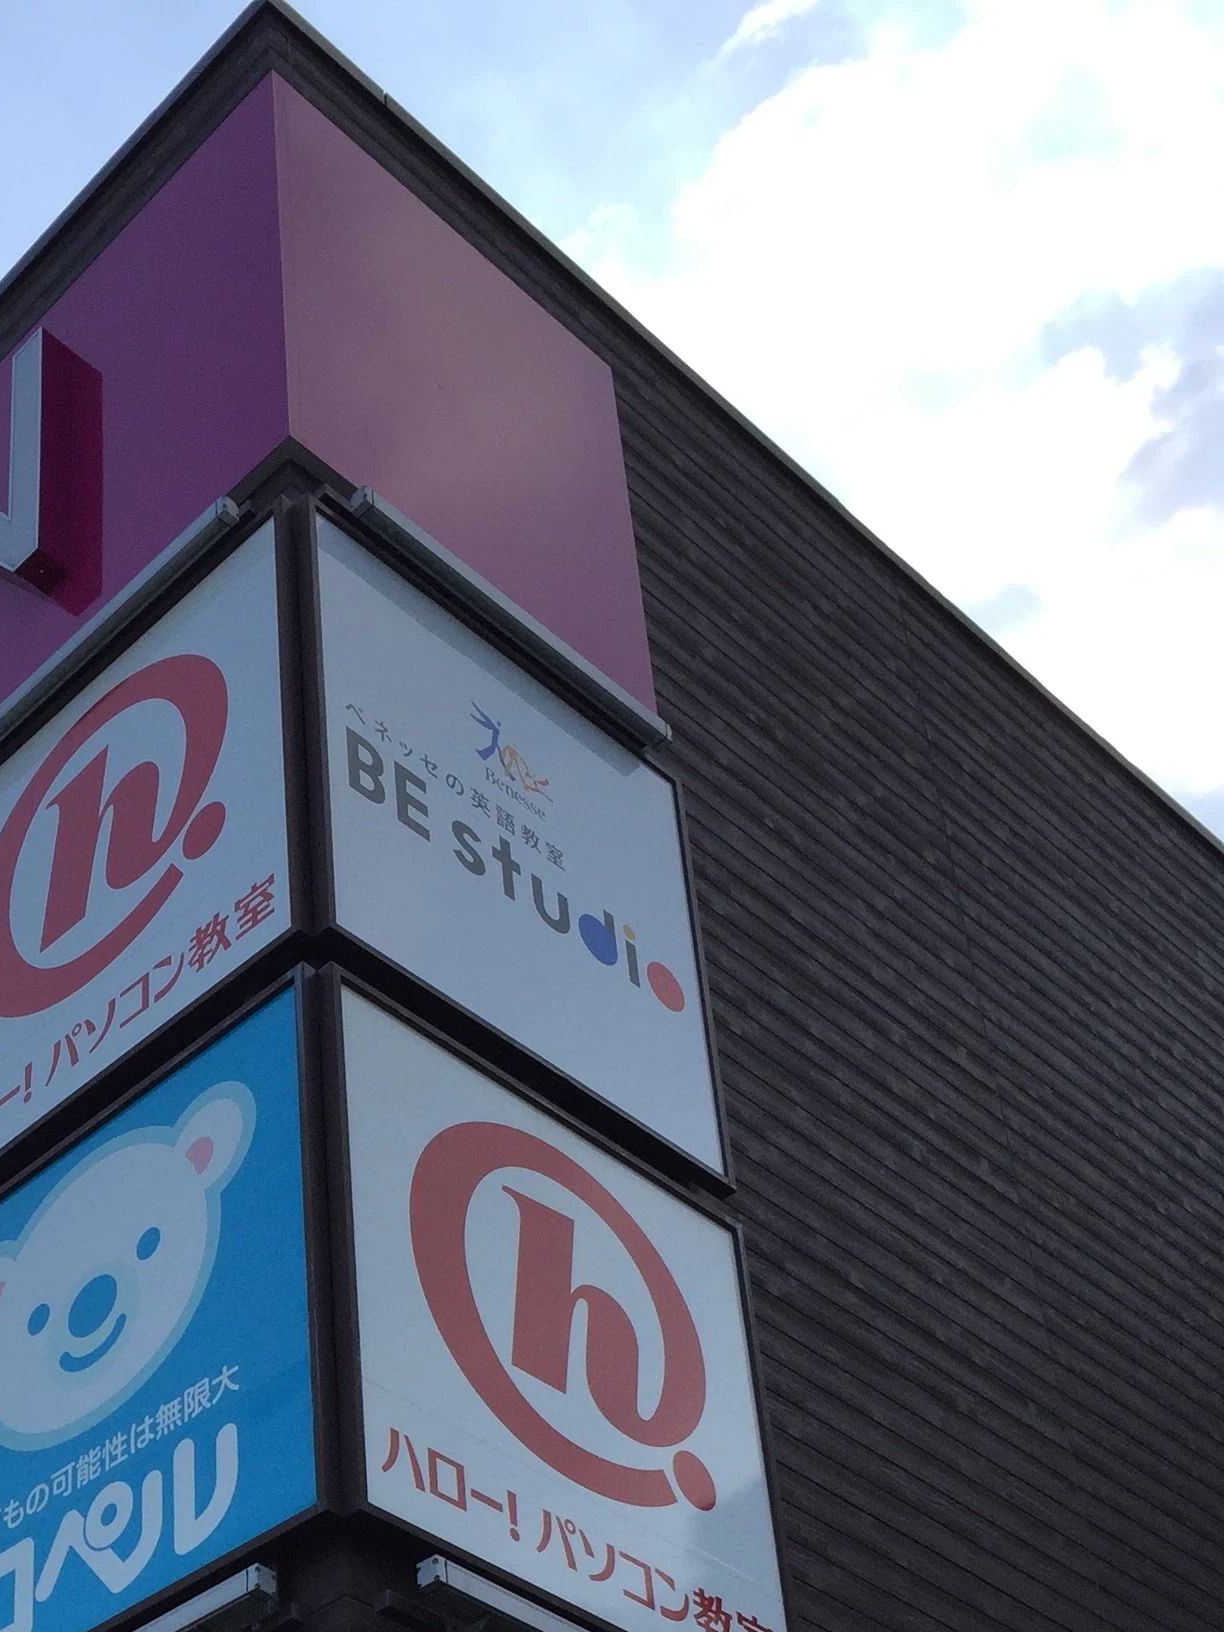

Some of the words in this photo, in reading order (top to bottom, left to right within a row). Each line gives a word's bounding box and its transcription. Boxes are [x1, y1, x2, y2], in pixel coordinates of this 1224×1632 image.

[345, 725, 431, 842] BE
[345, 702, 566, 872] ベネッセの英語教室
[484, 765, 546, 823] Benesse
[45, 872, 276, 1087] パソコン教室
